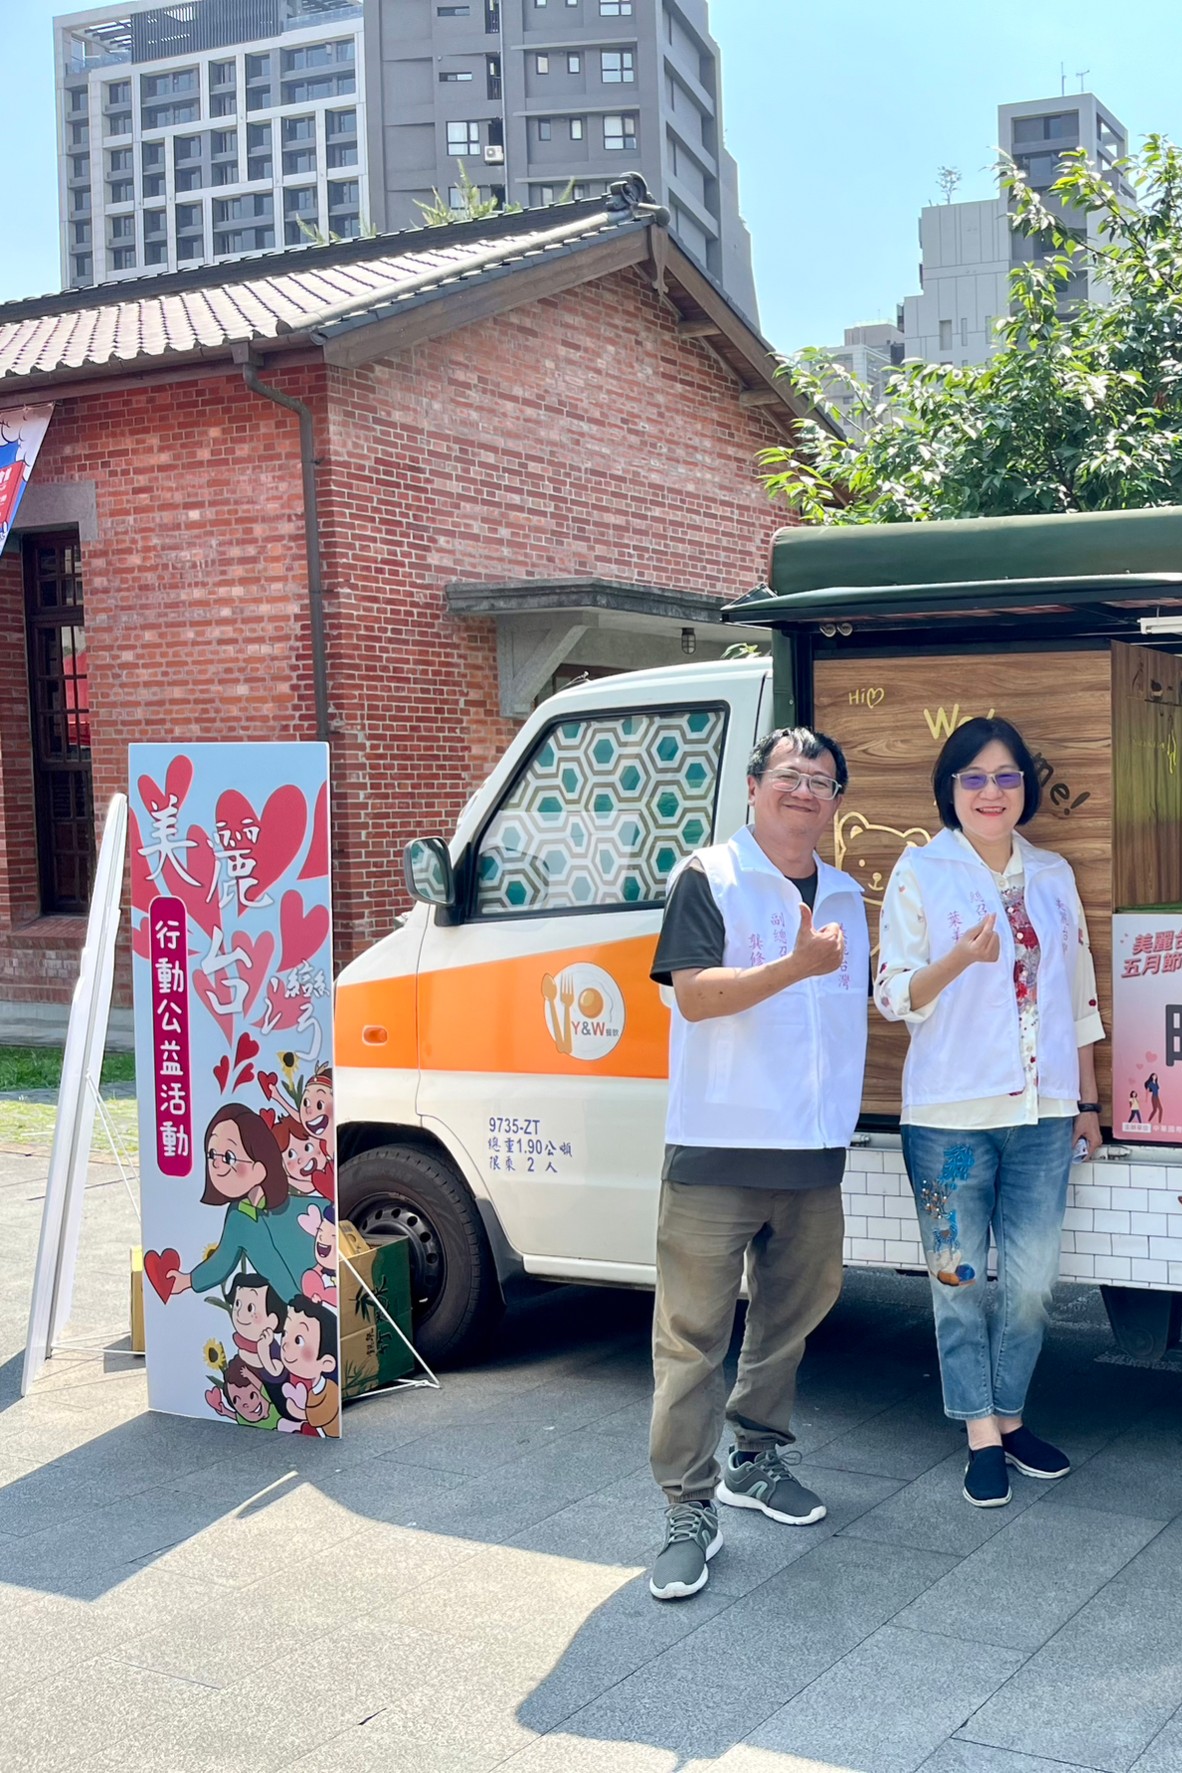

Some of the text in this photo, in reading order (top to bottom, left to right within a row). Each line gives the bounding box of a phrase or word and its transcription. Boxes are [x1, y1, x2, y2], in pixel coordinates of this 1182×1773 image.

[848, 688, 866, 706] Hi
[571, 1020, 606, 1036] Y&W
[154, 918, 190, 1159] 行動公益活動
[488, 1116, 541, 1136] 9735-ZT
[526, 1156, 535, 1173] 2
[544, 1161, 558, 1174] 人
